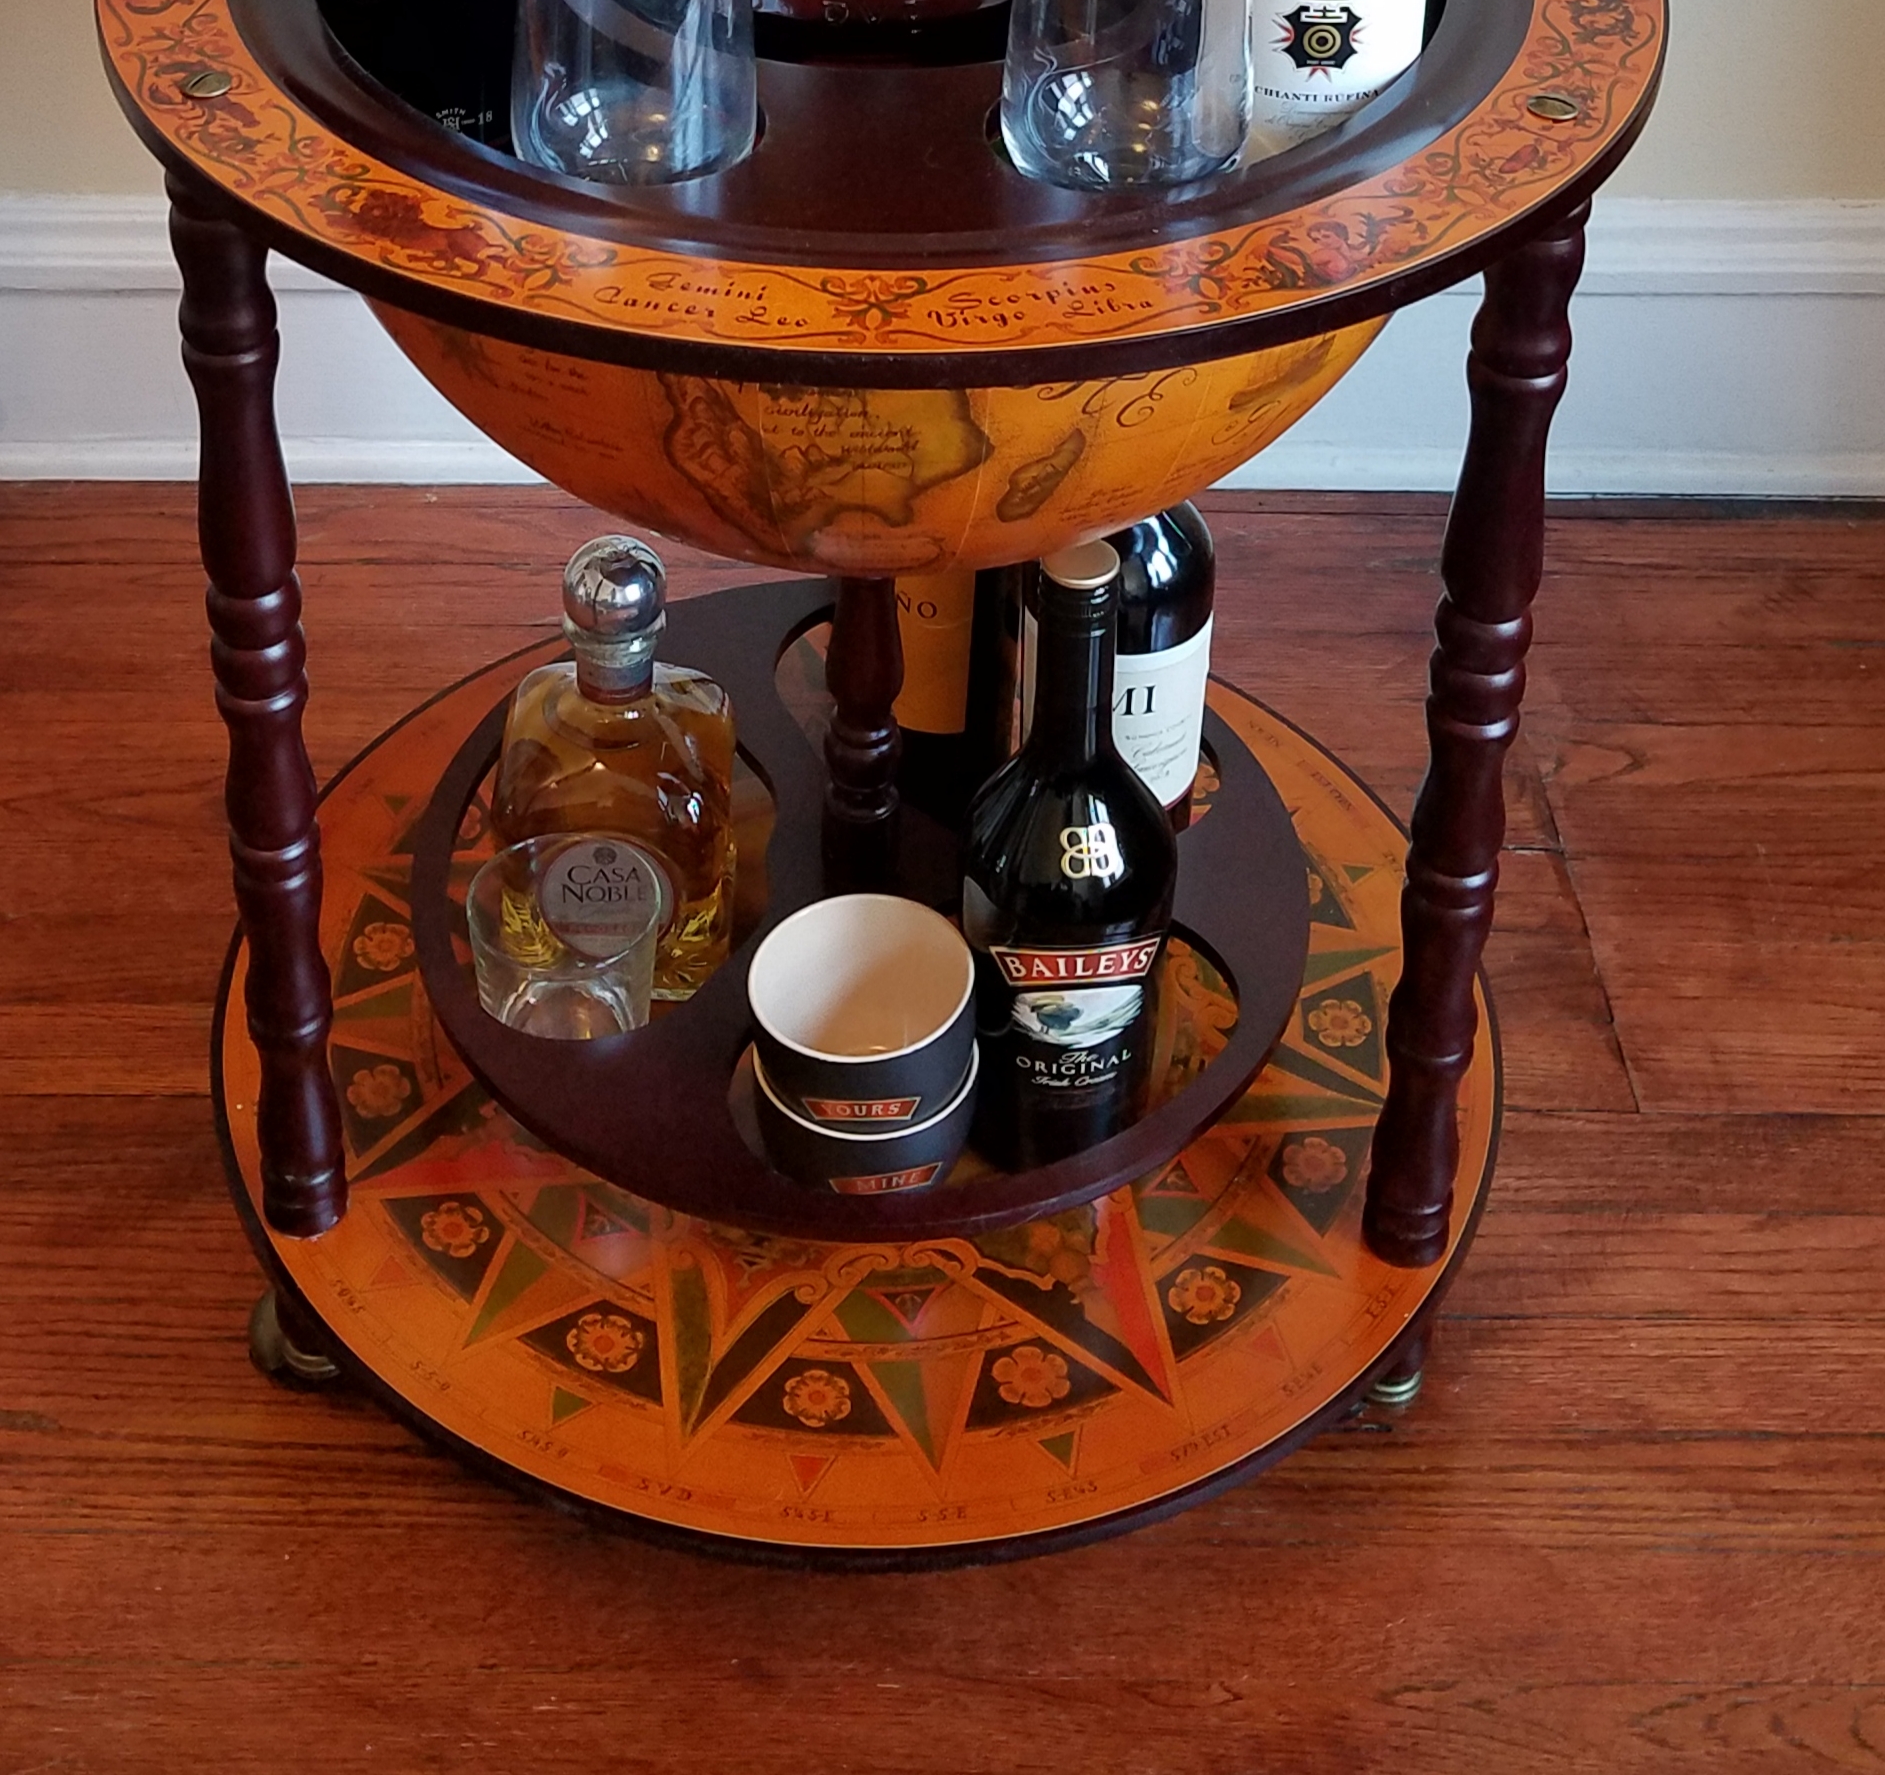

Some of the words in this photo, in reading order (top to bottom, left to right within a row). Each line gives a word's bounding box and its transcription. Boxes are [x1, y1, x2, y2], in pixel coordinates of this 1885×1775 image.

[1254, 85, 1319, 103] CHIANTI
[646, 273, 768, 302] Gemini
[594, 286, 715, 318] Cancer
[735, 306, 809, 328] Leo
[927, 309, 1025, 328] Virgo
[1062, 298, 1154, 319] Libra
[566, 865, 642, 885] CASA
[561, 883, 648, 904] NOBLE
[1003, 946, 1156, 978] BAILEYS
[1016, 1049, 1131, 1075] ORIGINAL
[1059, 1050, 1100, 1064] The
[821, 1103, 902, 1116] YOURS
[856, 1171, 922, 1192] MINE
